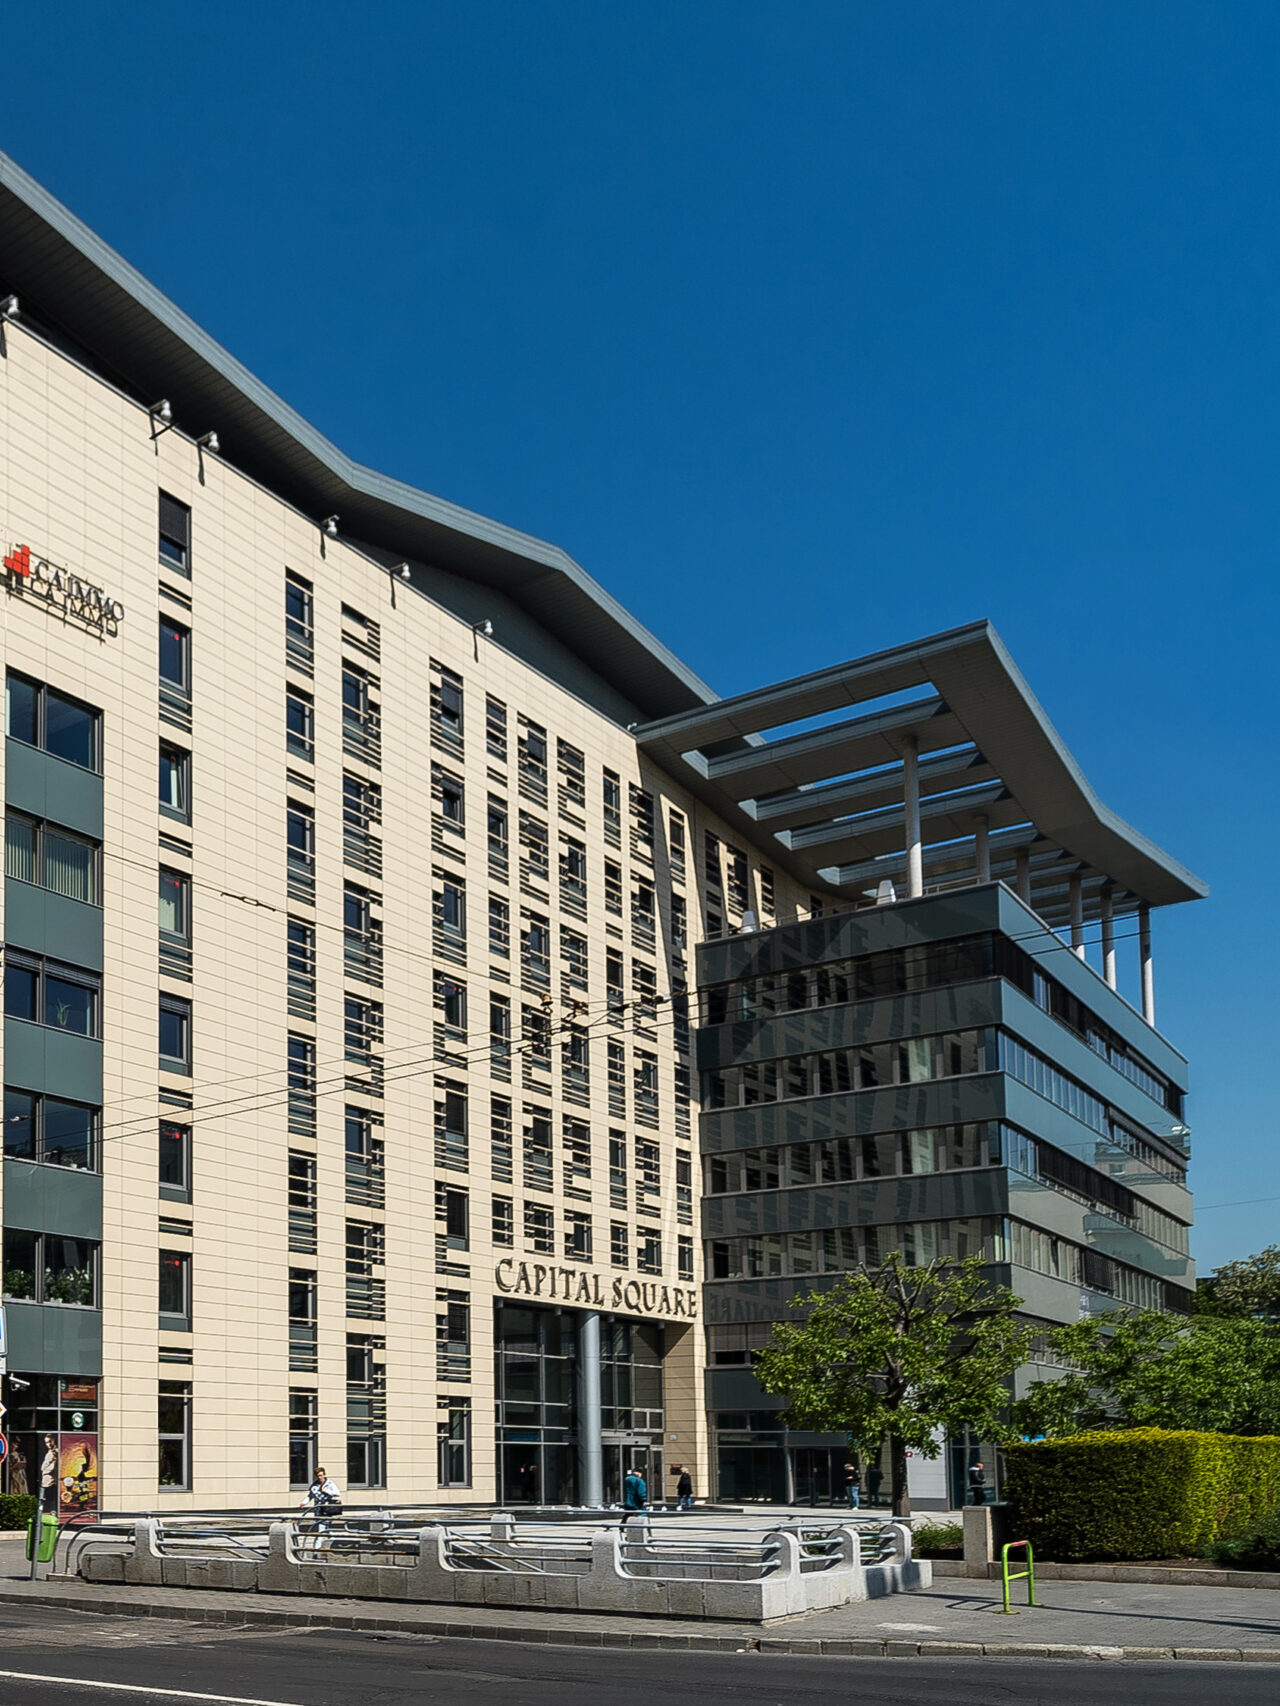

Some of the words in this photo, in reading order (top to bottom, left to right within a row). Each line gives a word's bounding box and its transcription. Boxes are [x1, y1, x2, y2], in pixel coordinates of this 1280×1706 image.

[35, 561, 63, 591] CA
[68, 575, 125, 622] IMMO
[495, 1257, 605, 1307] CAPITAL
[612, 1276, 698, 1318] SQUARE
